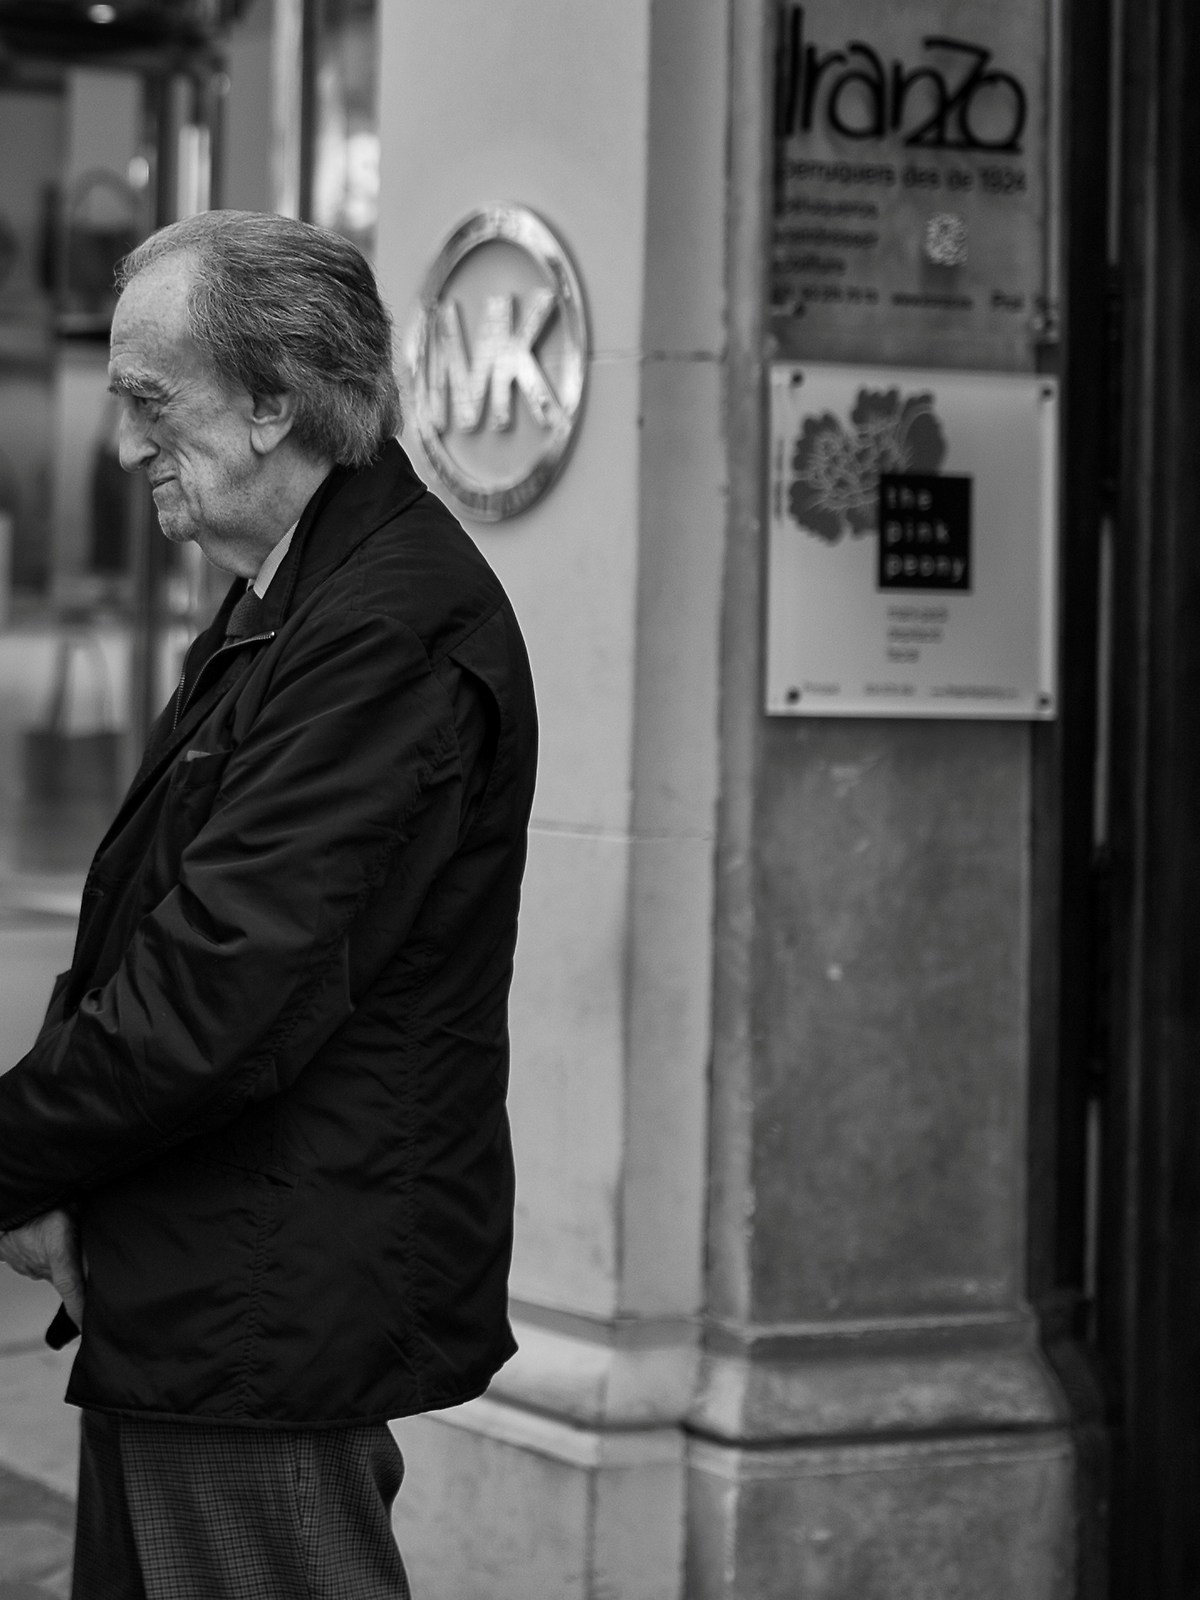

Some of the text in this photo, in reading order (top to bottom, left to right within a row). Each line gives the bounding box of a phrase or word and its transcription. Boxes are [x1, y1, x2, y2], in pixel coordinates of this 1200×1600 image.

[417, 292, 568, 436] MK
[885, 484, 932, 512] the
[885, 517, 951, 548] pink
[885, 553, 966, 583] peony
